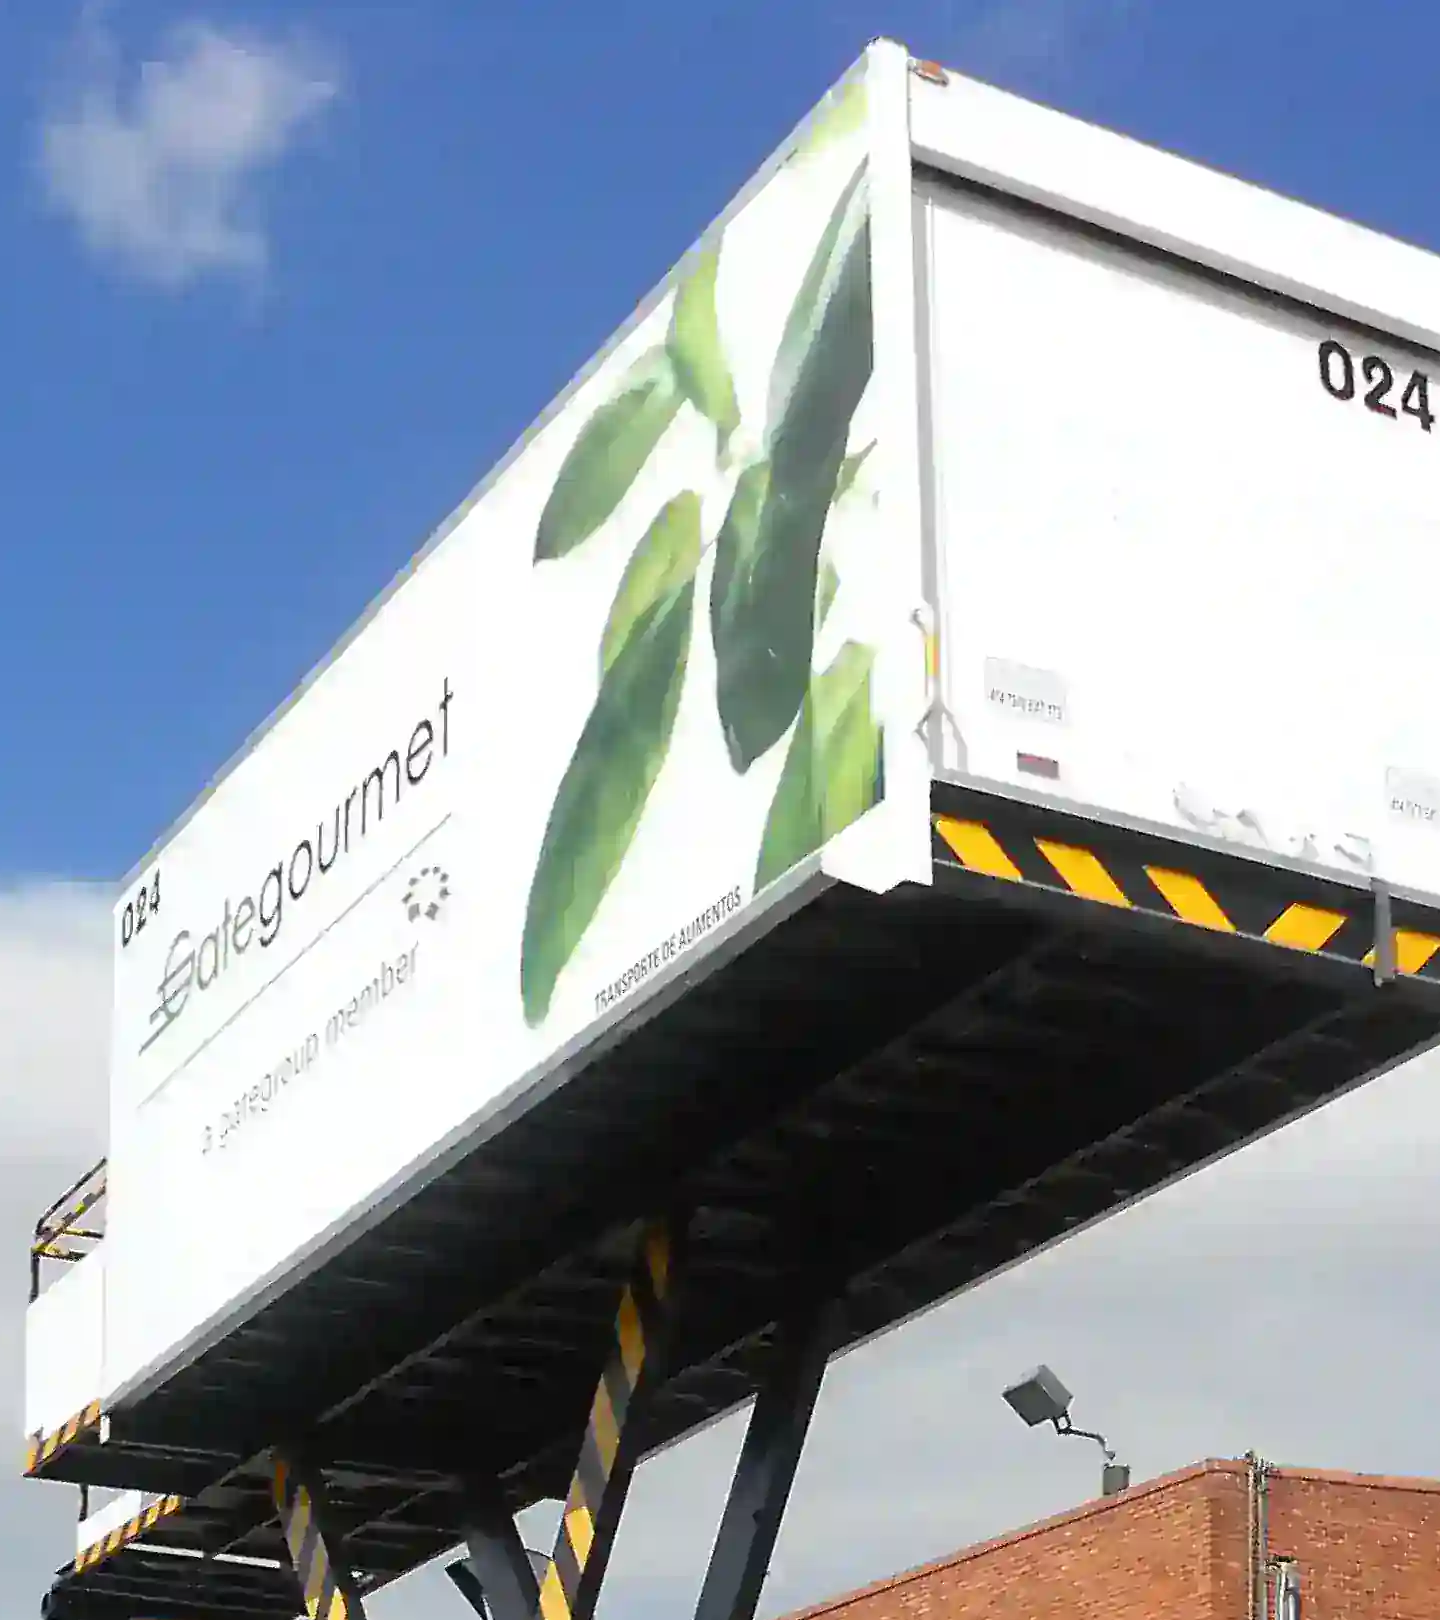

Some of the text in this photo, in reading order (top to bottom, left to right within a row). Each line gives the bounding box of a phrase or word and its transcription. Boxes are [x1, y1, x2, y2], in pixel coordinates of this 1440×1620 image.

[1318, 339, 1435, 434] 024
[122, 867, 160, 948] 024
[594, 885, 741, 1014] TRANSPORTE DE ALIMENTOS
[325, 940, 419, 1045] member
